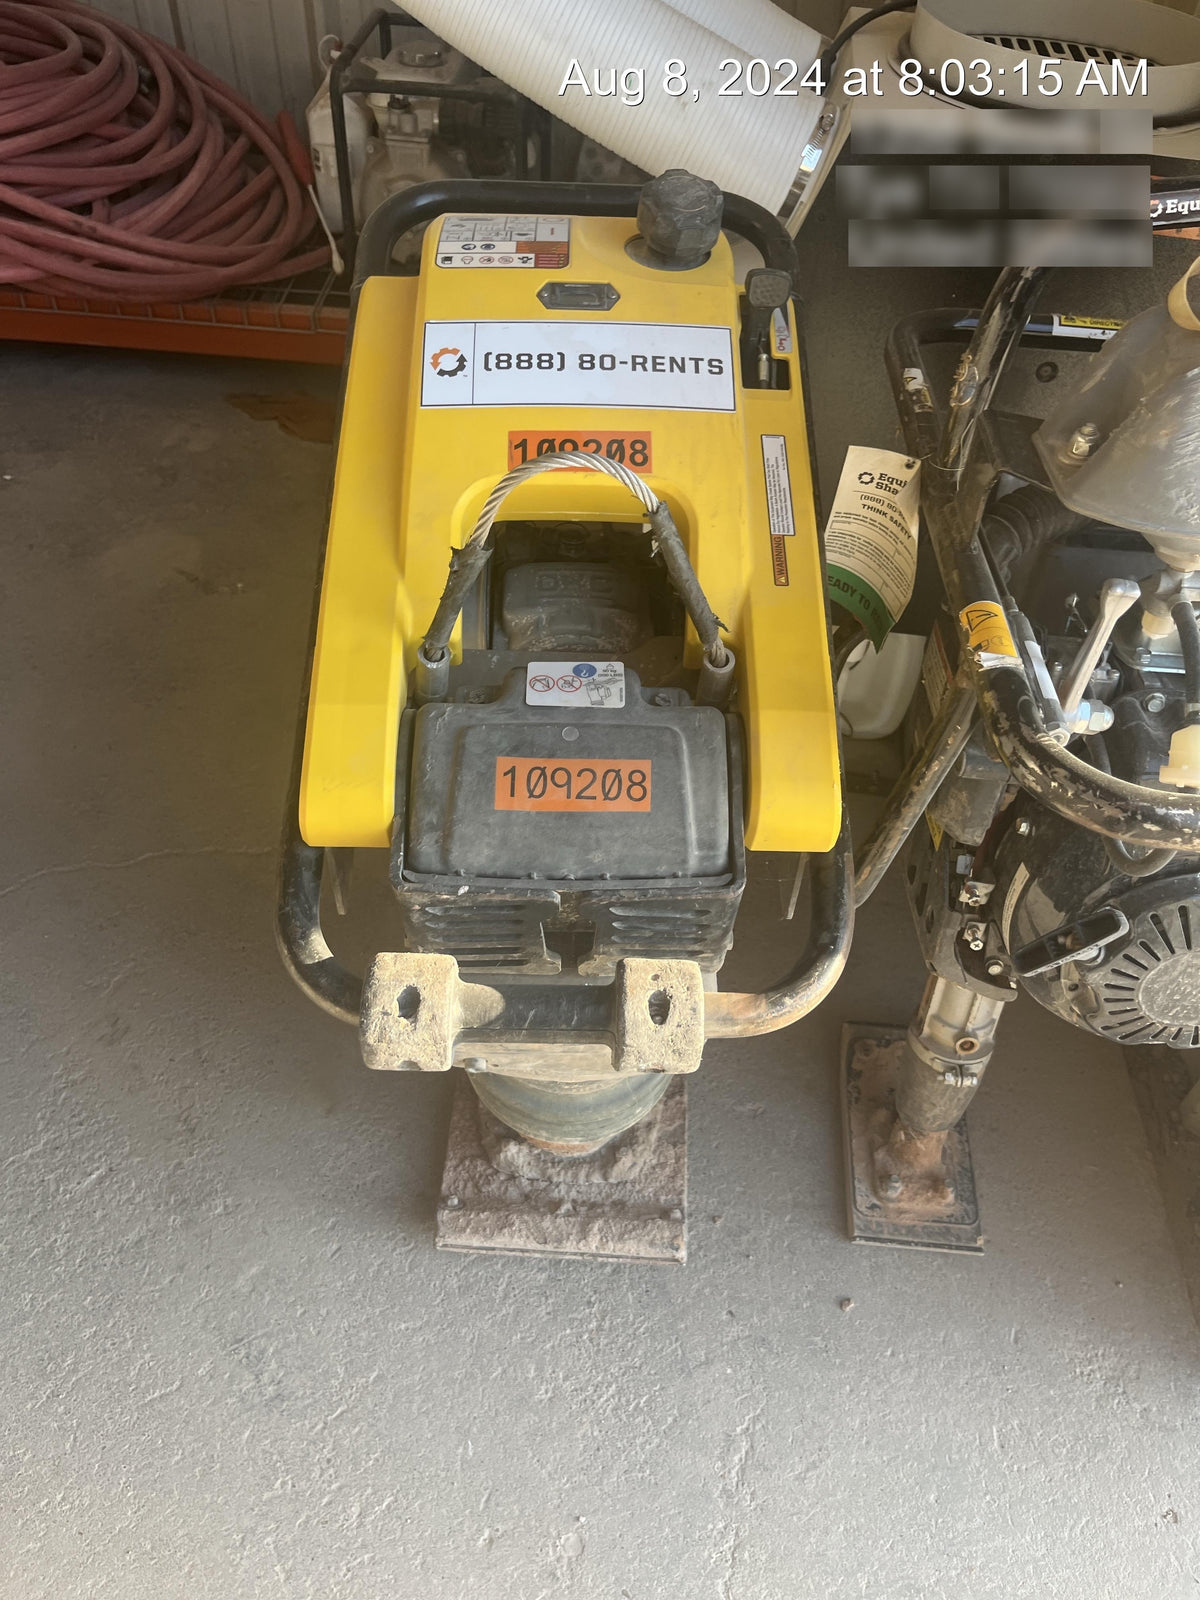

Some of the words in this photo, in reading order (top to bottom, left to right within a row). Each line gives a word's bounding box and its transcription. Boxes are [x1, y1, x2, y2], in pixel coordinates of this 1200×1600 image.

[483, 352, 566, 372] (888)
[578, 353, 724, 376] 80-RENTS
[861, 503, 889, 518] THINK
[889, 515, 912, 540] SAFETY
[773, 536, 785, 576] WARNING
[827, 575, 857, 598] EADY
[502, 765, 648, 802] 109208
